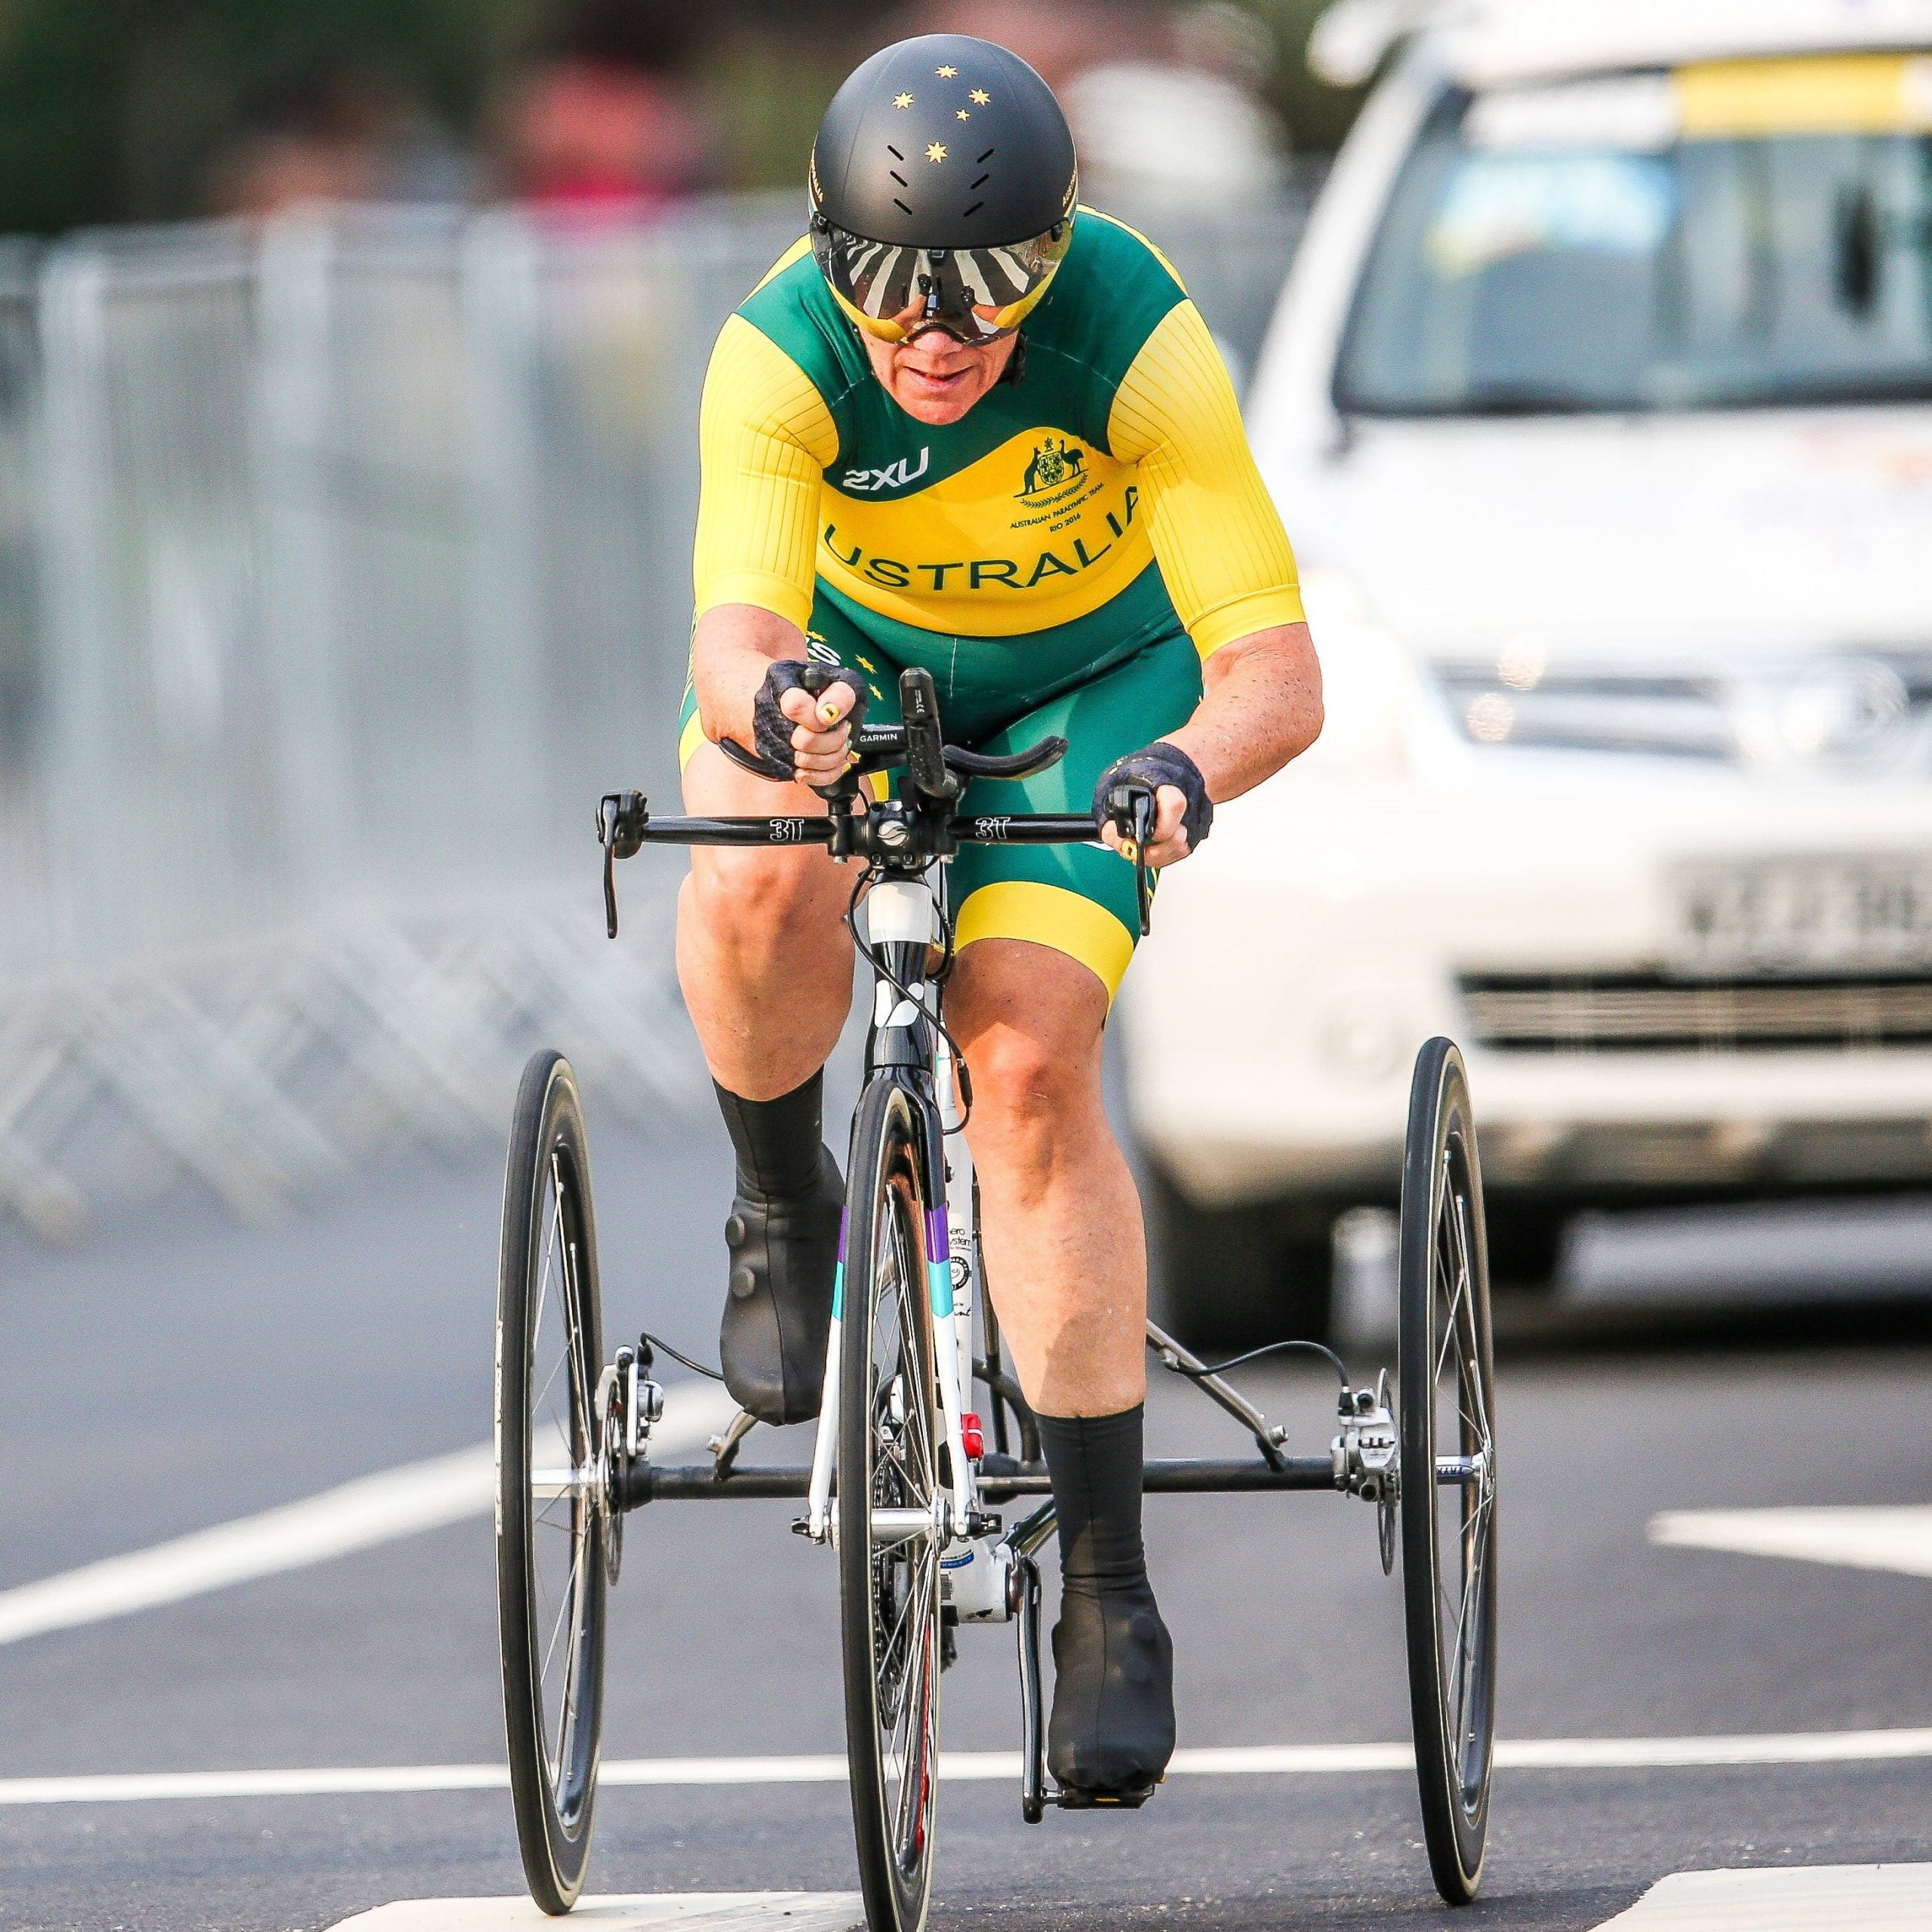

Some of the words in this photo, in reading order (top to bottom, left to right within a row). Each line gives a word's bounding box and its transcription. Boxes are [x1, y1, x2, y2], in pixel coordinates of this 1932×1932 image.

[842, 446, 929, 491] 2XU
[1010, 513, 1051, 529] AUSTRALIAN
[1053, 494, 1089, 518] PARALYMPIC
[1089, 482, 1104, 497] TEAM
[1049, 522, 1063, 533] RIO
[1065, 512, 1081, 527] 2016
[860, 733, 898, 743] GARMIN
[769, 818, 804, 841] 3T
[975, 817, 1011, 839] 3T
